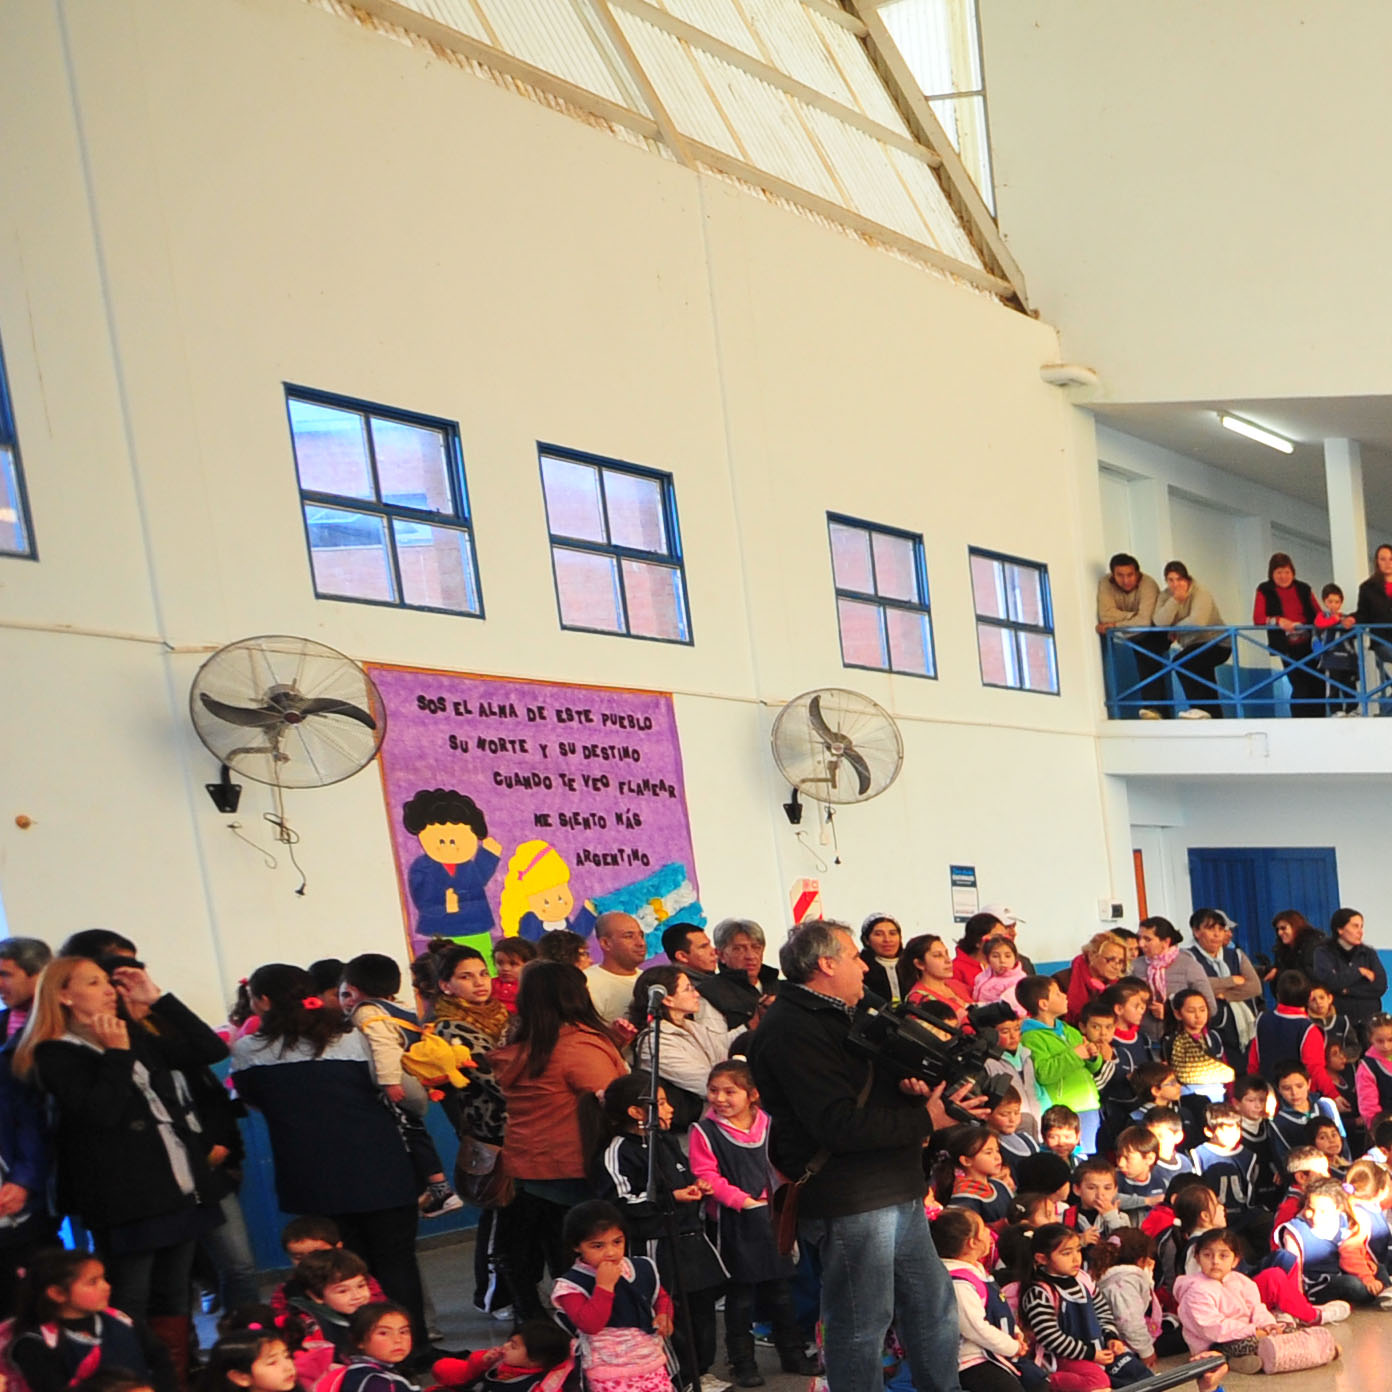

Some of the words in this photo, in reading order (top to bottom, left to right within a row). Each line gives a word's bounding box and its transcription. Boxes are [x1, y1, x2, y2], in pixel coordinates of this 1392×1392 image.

[417, 695, 447, 714] SOS
[453, 701, 473, 717] EL
[479, 701, 518, 719] ALMA
[526, 706, 546, 722] DE
[556, 707, 594, 724] ESTE
[602, 712, 653, 731] PUEBLO
[477, 735, 528, 754] NORTE
[539, 743, 548, 758] Y
[559, 742, 576, 756] SU
[583, 744, 641, 762] DESTINO
[493, 771, 553, 791] CUANDO
[559, 773, 576, 792] TE
[582, 774, 610, 792] VEO
[618, 779, 677, 799] FLAMEAR
[534, 813, 552, 828] ME
[558, 813, 607, 830] SIENTO
[615, 808, 642, 830] MÁS
[576, 849, 651, 867] ARGENTINO
